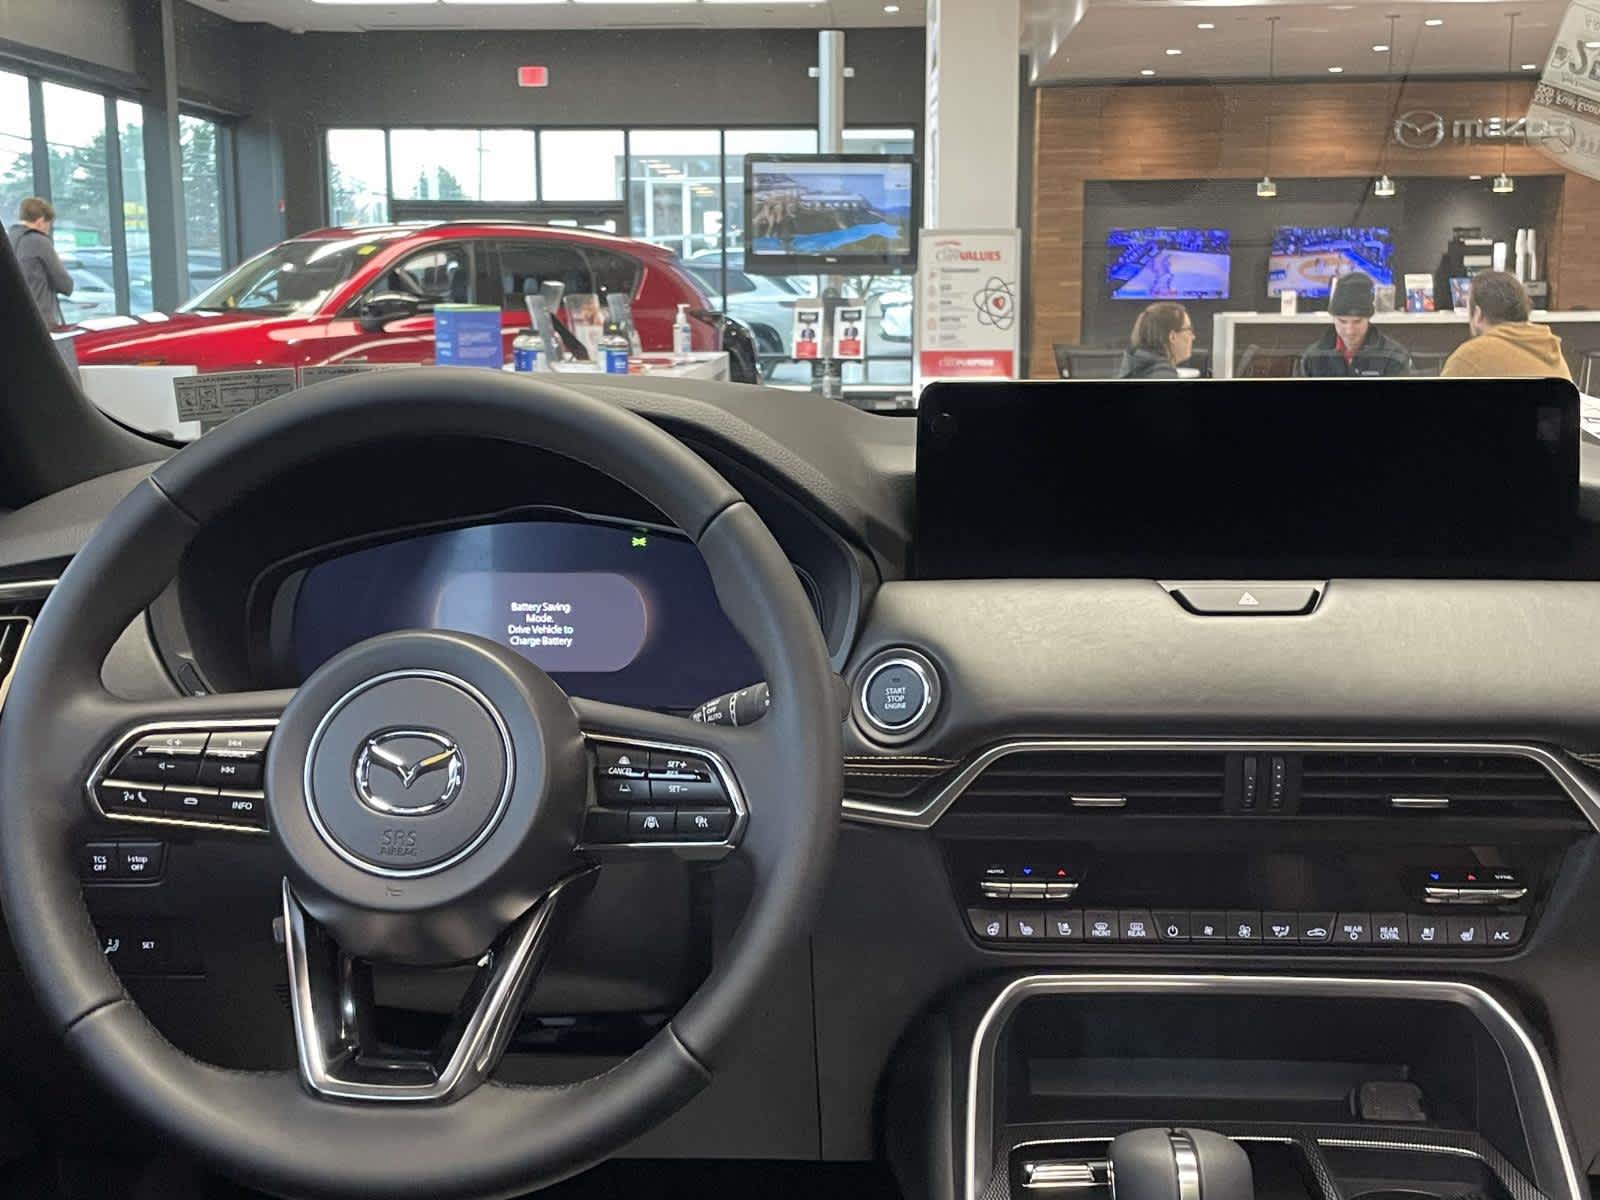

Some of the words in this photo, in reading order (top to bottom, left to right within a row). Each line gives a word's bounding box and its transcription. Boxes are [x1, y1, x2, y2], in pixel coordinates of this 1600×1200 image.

[511, 602, 541, 613] Battery
[542, 602, 571, 614] Saving
[525, 613, 554, 623] Mode.
[508, 624, 531, 634] Drive
[531, 624, 563, 634] Vehicle
[563, 625, 574, 634] to
[509, 636, 541, 647] Charge
[542, 636, 573, 647] Battery
[885, 687, 906, 695] START
[887, 695, 905, 703] STOP
[884, 702, 906, 710] ENGINE
[707, 712, 723, 722] AUTO
[232, 801, 253, 810] INFO
[381, 829, 417, 846] SRS
[93, 855, 107, 863] TCS
[93, 864, 107, 872] OFF
[1091, 929, 1111, 937] FRONT
[1127, 929, 1146, 937] REAR
[1343, 925, 1363, 933] REAR
[1494, 930, 1509, 940] A/C
[142, 941, 155, 949] SET
